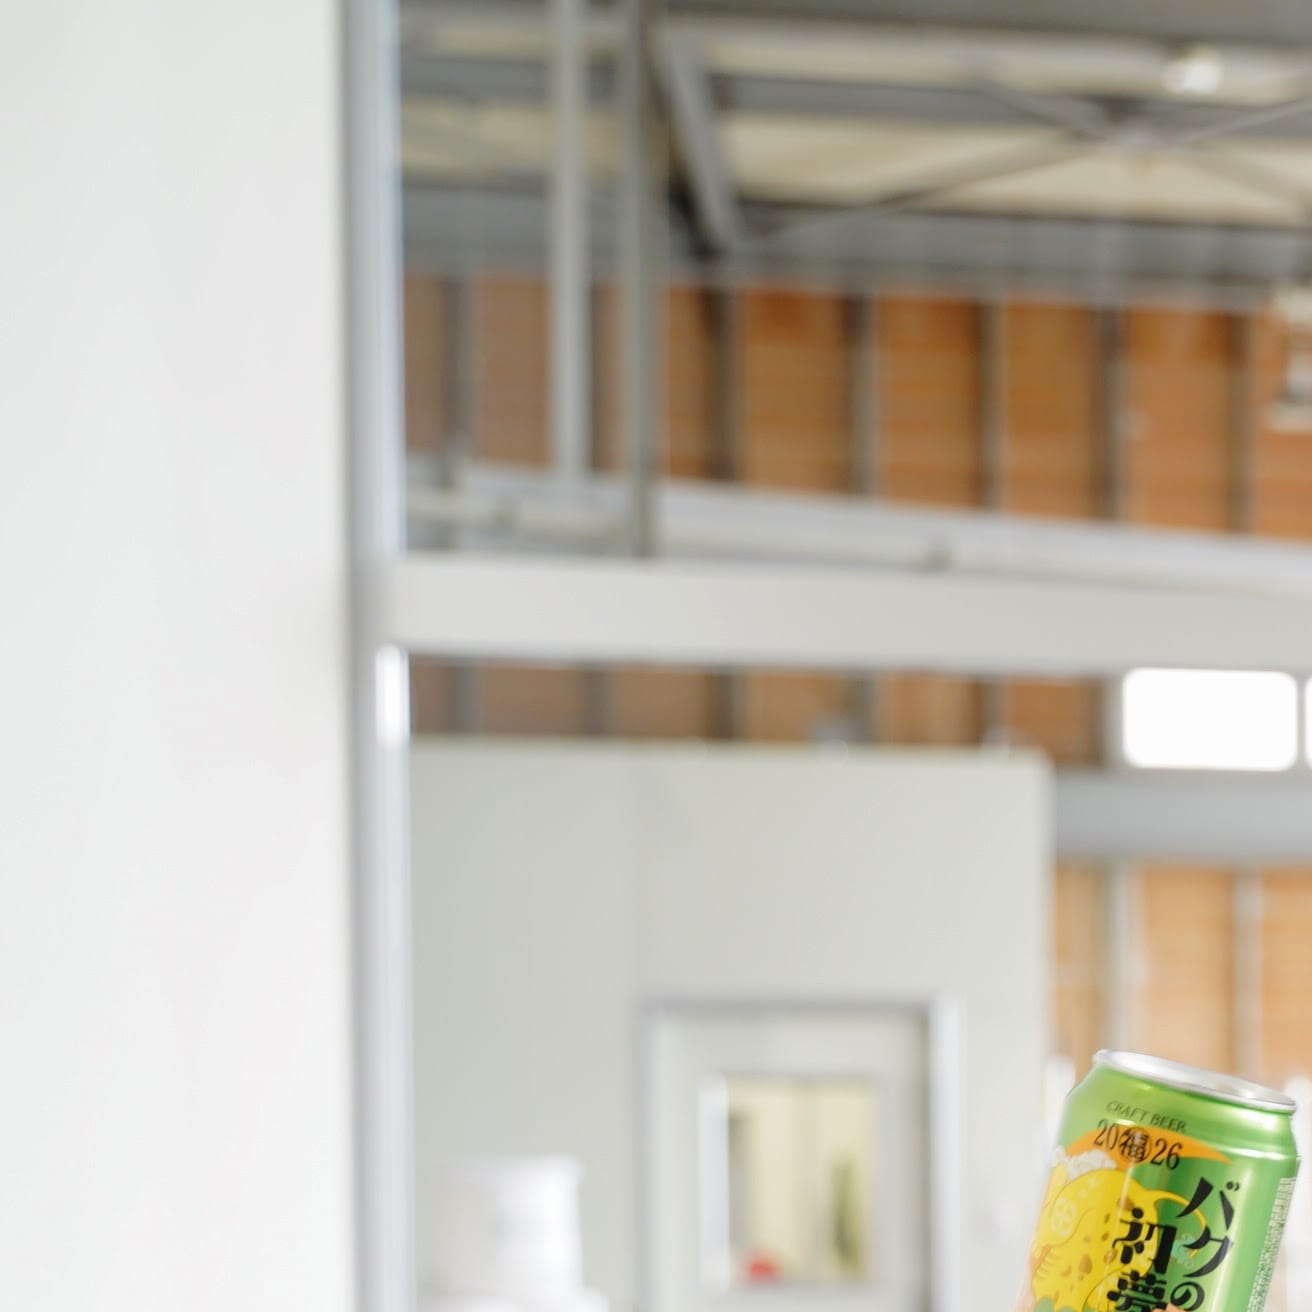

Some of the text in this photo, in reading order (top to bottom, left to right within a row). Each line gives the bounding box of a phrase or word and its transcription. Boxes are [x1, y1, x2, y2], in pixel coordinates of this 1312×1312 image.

[1106, 1100, 1187, 1134] CRAFT BEER
[1169, 1177, 1241, 1312] バクの
